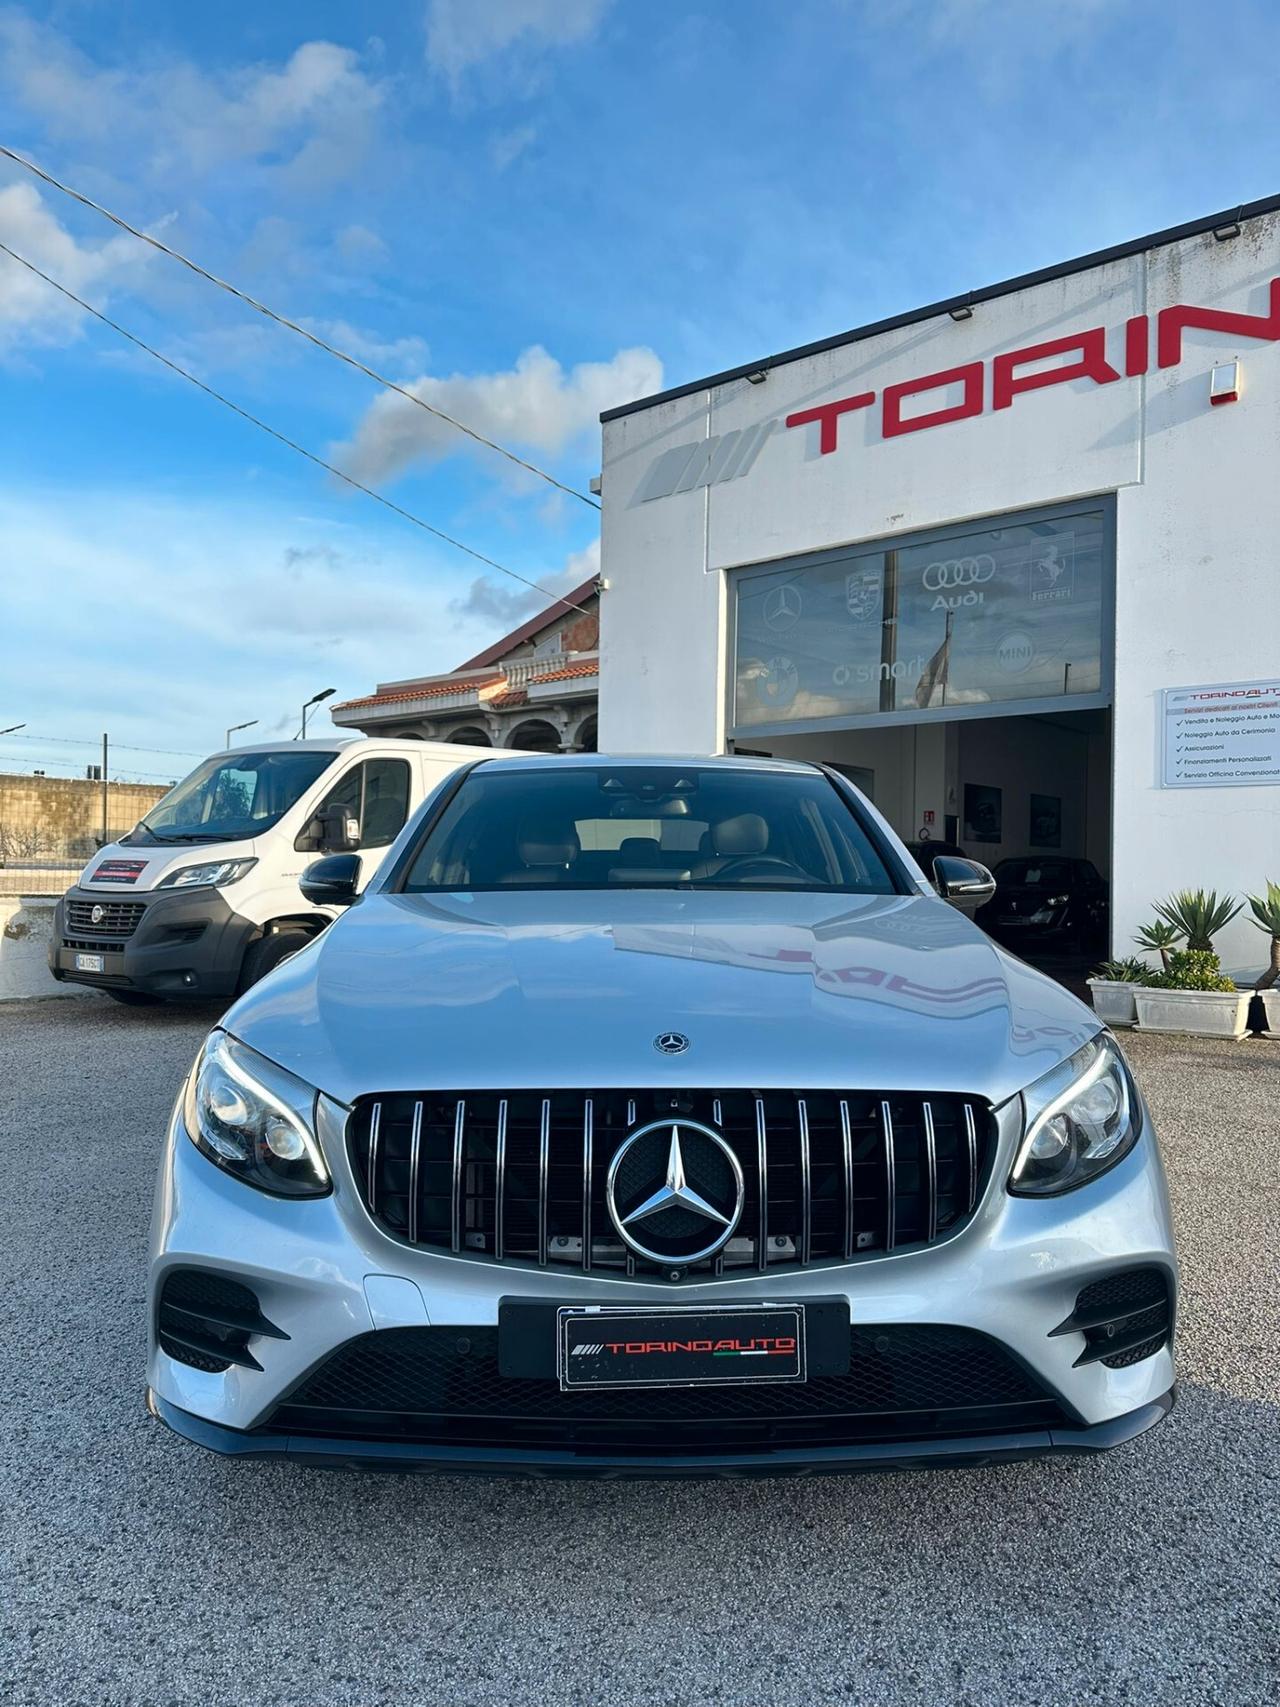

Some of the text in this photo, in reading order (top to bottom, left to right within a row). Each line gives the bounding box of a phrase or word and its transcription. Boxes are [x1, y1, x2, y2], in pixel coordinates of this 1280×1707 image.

[930, 590, 984, 611] Audi
[1032, 588, 1071, 601] Ferrari
[999, 646, 1031, 661] MINI
[856, 655, 926, 683] smart
[1215, 715, 1245, 724] Noleggio
[1184, 731, 1213, 739] Noleggio
[1241, 727, 1276, 735] Cerimonia
[1184, 744, 1224, 752] Assicurazioni
[1184, 755, 1271, 765] Finanziamenti Personalizzati
[605, 1337, 795, 1354] TORINOAUTO
